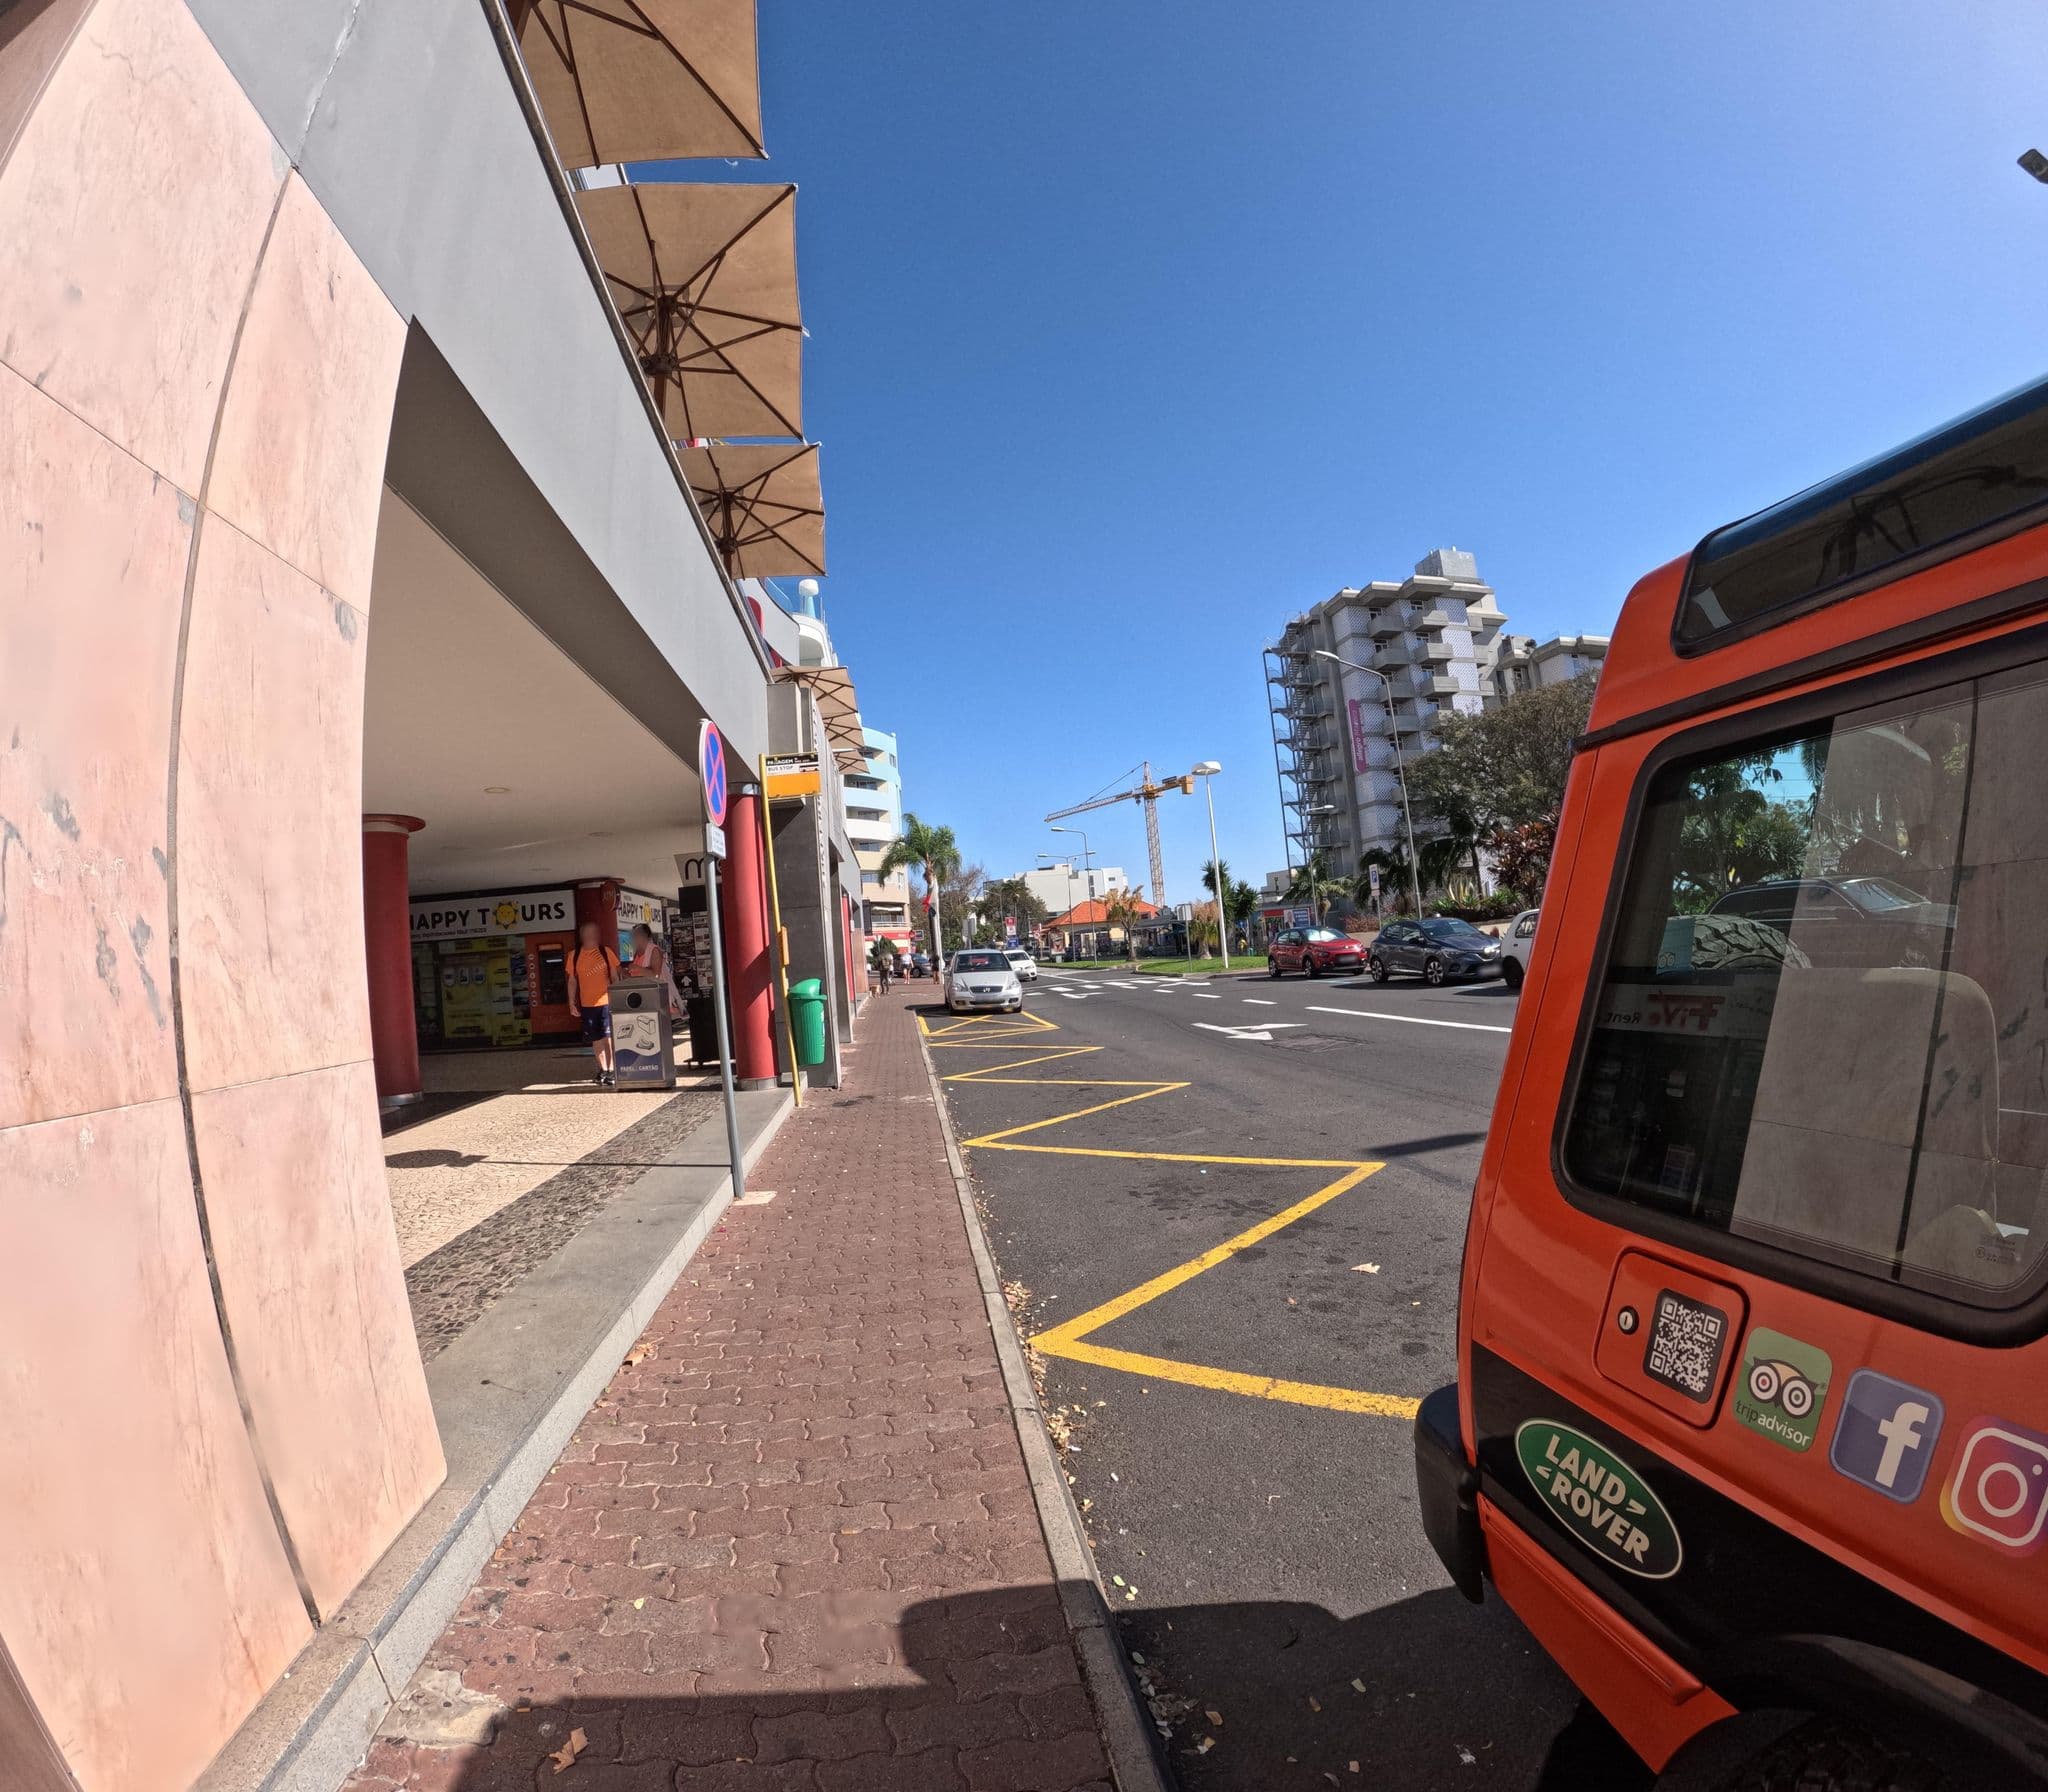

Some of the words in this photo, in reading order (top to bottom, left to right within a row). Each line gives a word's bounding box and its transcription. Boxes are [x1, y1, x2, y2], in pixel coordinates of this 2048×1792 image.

[1735, 1400, 1812, 1447] tripadvisor
[1545, 1433, 1627, 1505] LAND
[1550, 1471, 1650, 1563] ROVER
